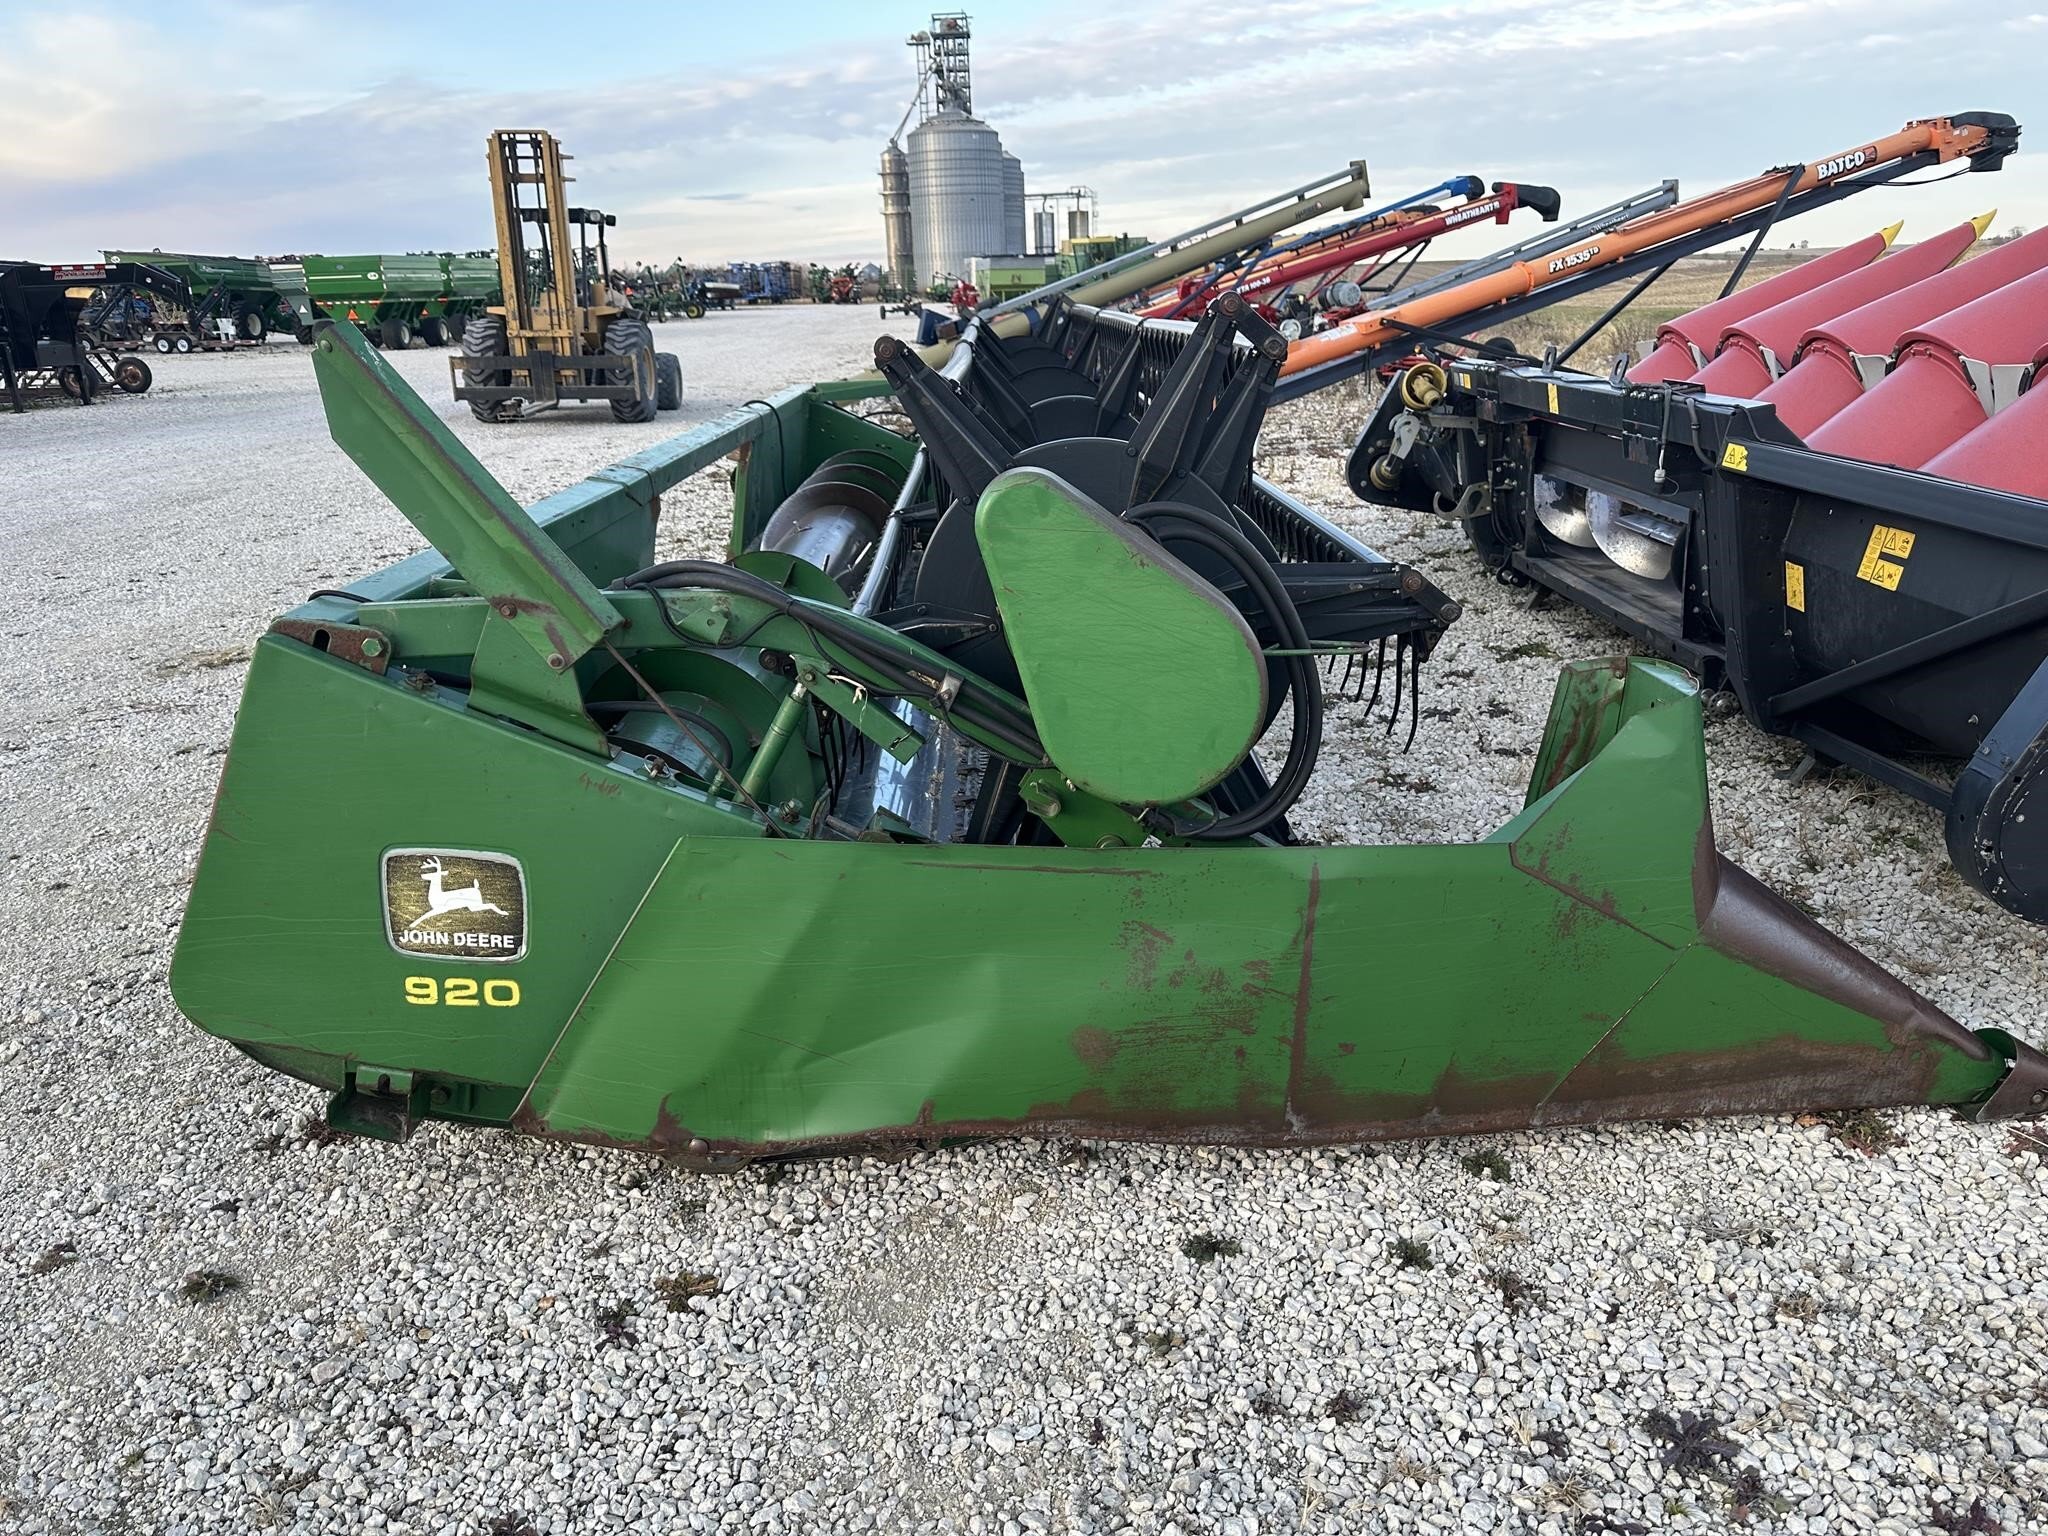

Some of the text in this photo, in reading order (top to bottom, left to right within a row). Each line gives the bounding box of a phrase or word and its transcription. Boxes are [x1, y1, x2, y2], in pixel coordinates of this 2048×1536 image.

[1816, 151, 1866, 180] BATCO
[1445, 202, 1494, 226] WHEATHEART
[1549, 257, 1564, 273] FX
[399, 929, 515, 949] JOHN DEERE
[404, 976, 521, 1008] 920
